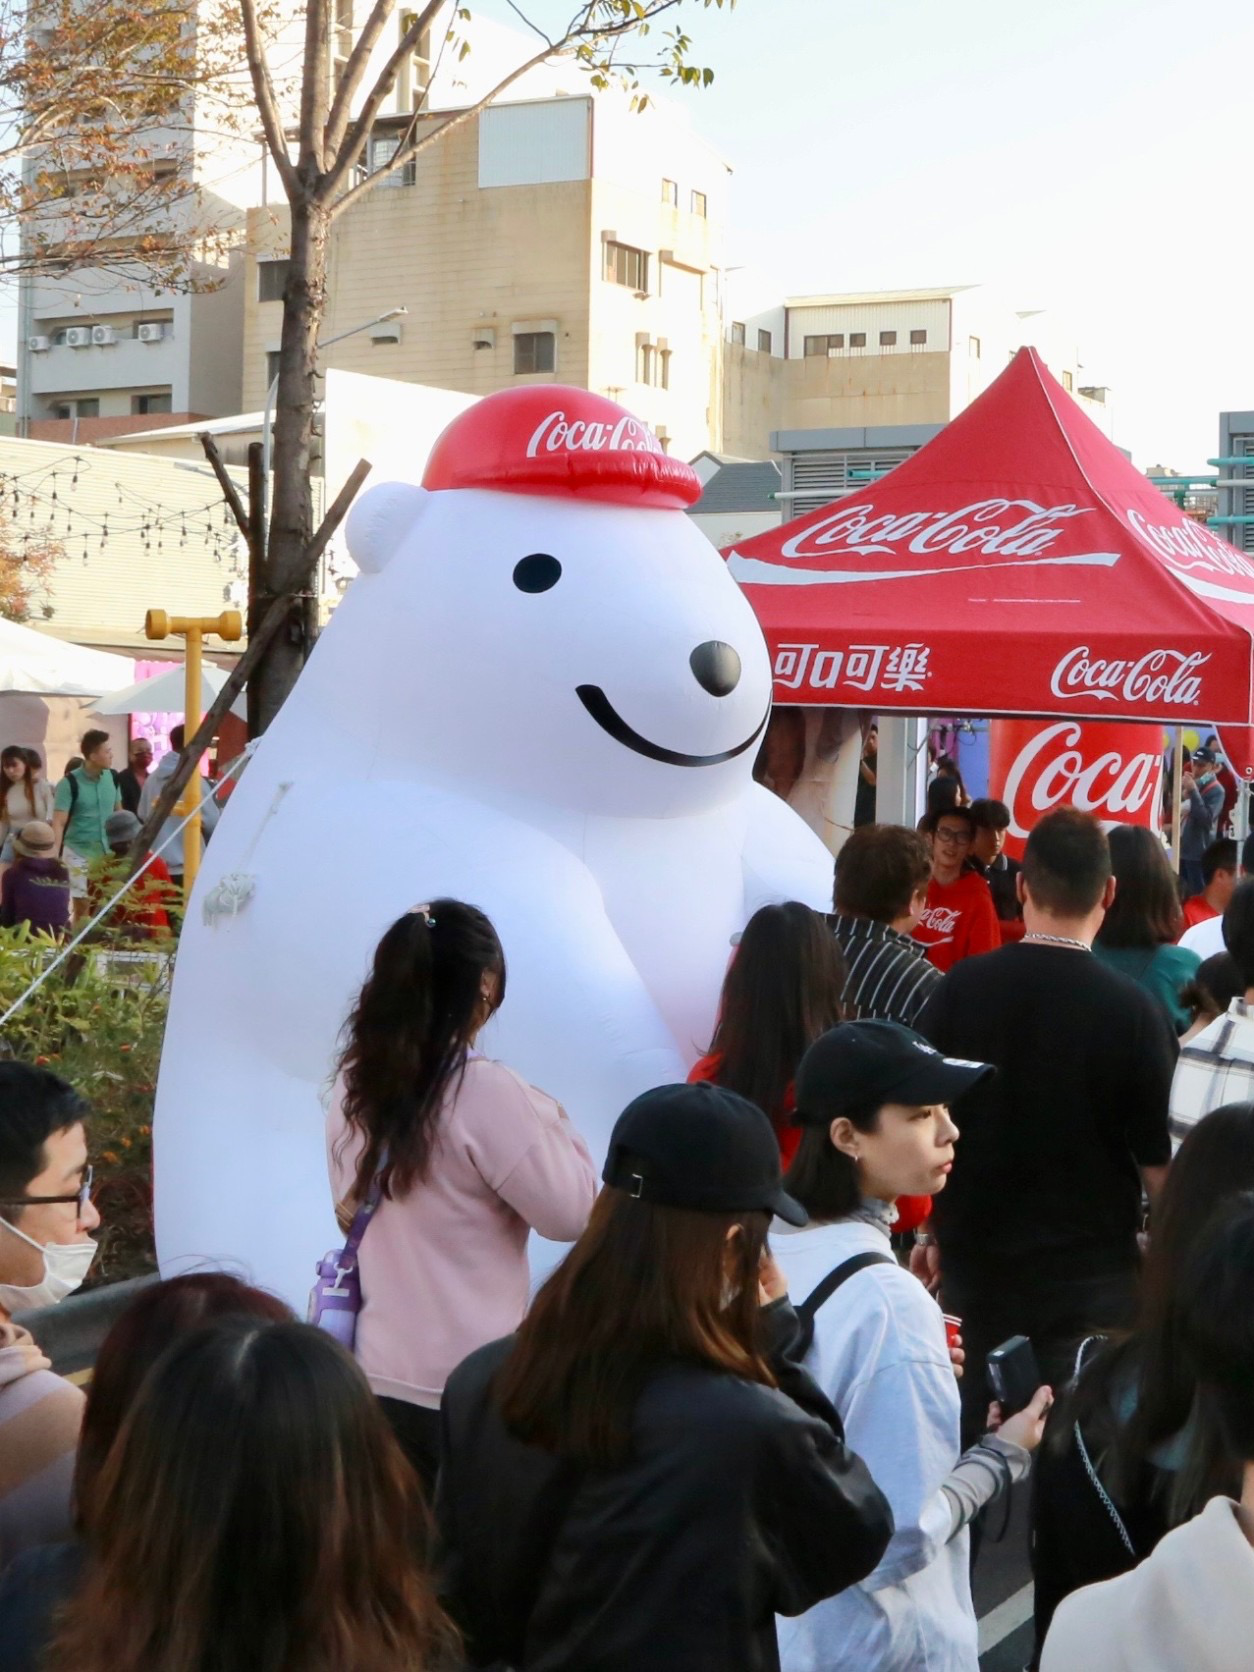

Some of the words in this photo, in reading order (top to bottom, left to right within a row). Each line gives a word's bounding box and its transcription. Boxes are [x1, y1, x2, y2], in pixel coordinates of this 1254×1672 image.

[781, 499, 1097, 558] Coca-Cola
[772, 642, 931, 692] 可口可樂
[1051, 646, 1212, 705] Coca-Cola
